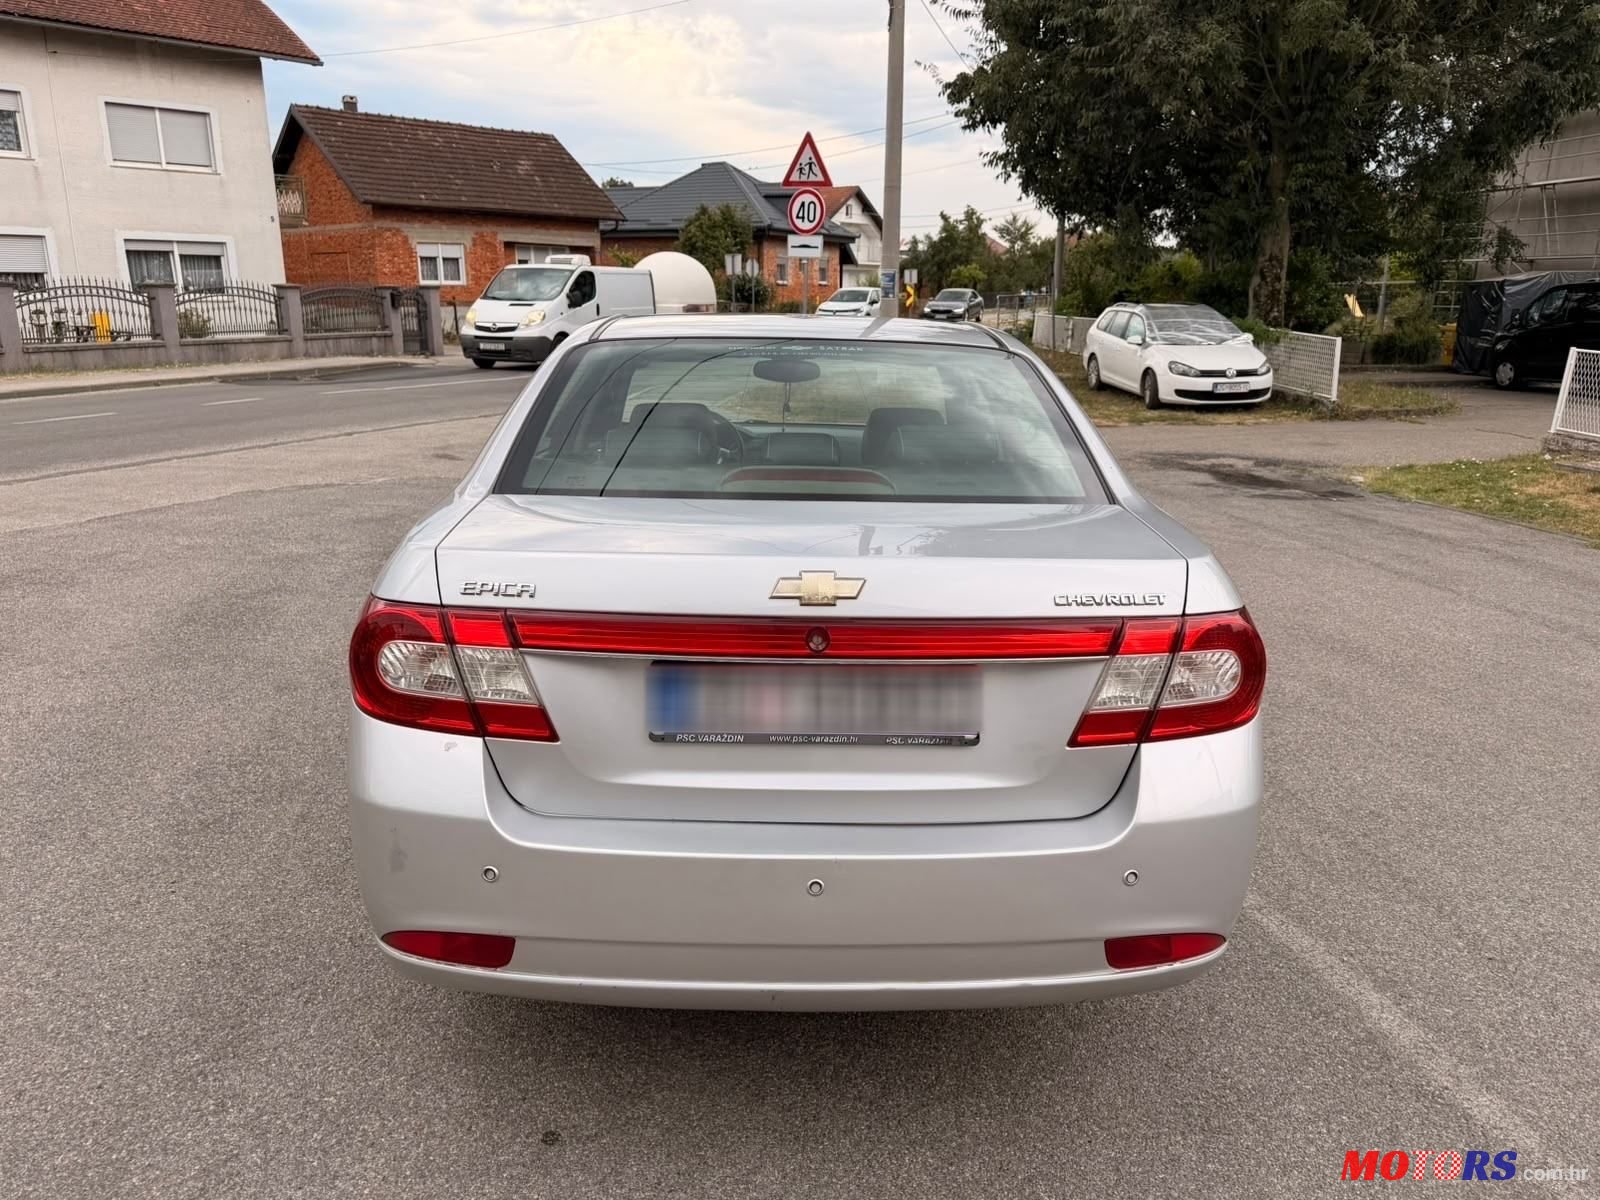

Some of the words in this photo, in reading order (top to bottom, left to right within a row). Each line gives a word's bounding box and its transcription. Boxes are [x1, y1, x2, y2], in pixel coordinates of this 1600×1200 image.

[796, 201, 817, 223] 40
[460, 581, 536, 598] EPICA
[1054, 593, 1167, 606] CHEVROLET
[676, 734, 695, 743] PSC
[698, 733, 744, 743] VARAŽDIN
